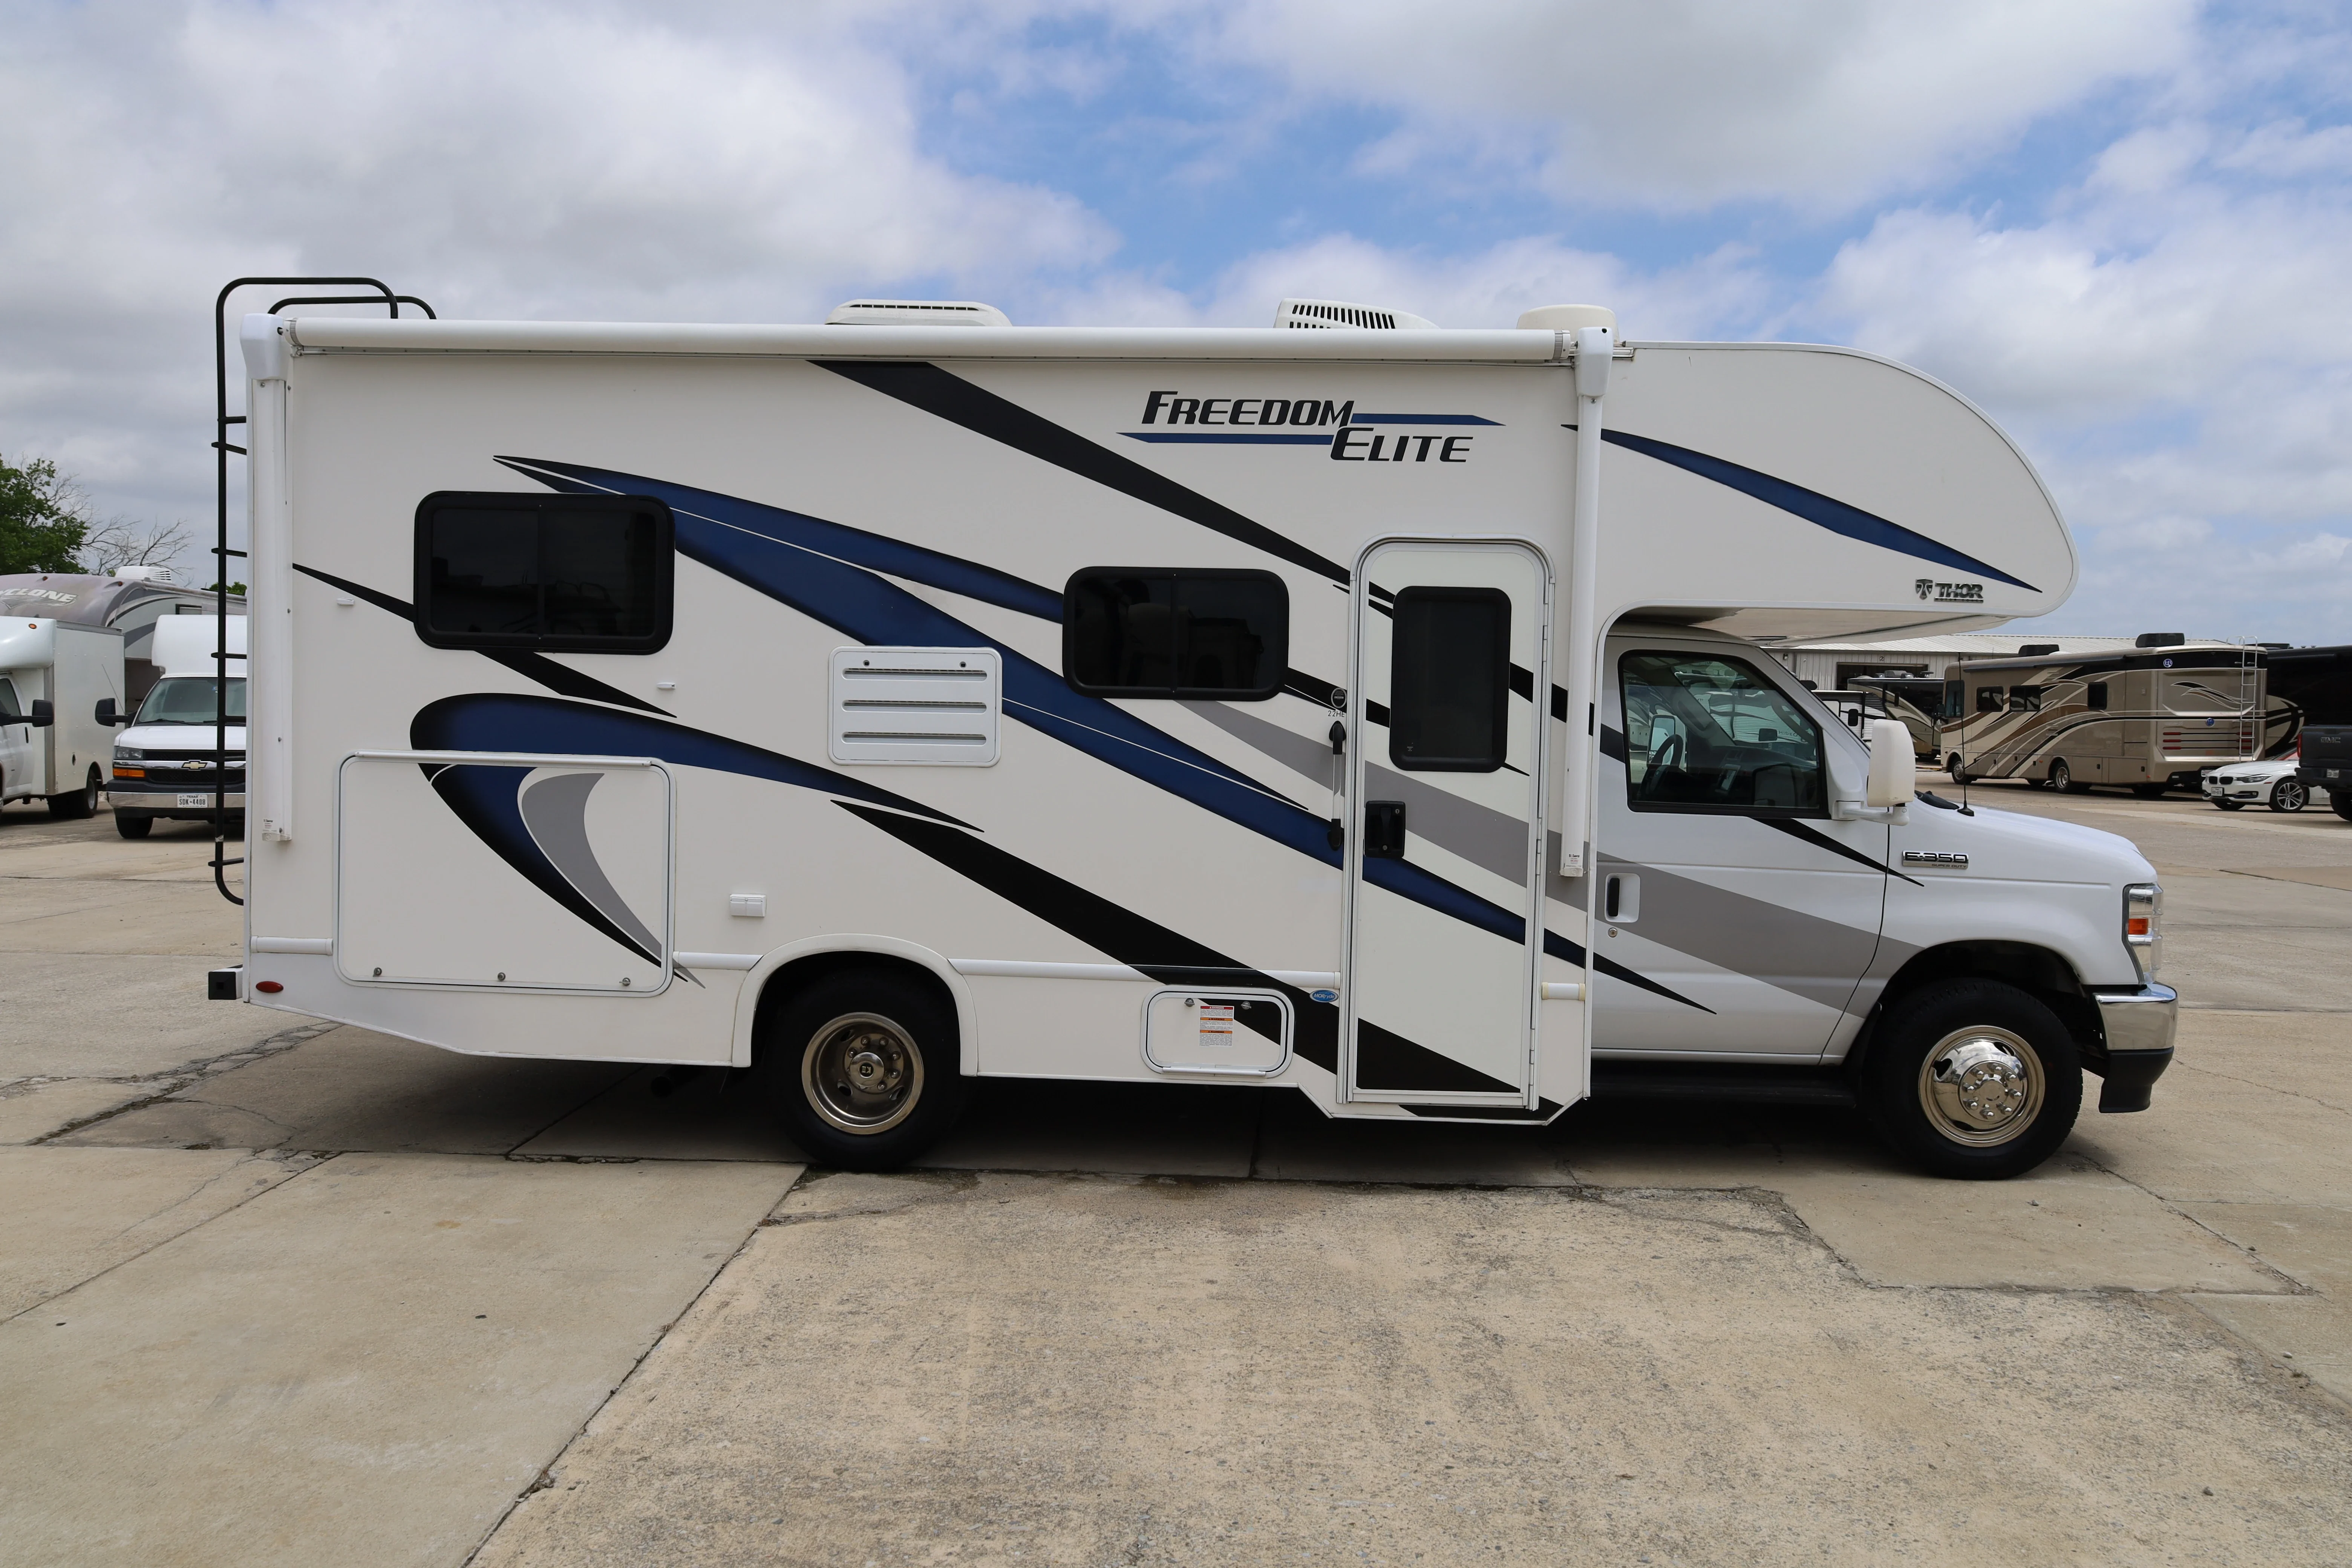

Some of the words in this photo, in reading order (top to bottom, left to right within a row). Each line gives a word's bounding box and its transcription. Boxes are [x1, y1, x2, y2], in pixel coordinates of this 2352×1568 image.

[1141, 390, 1355, 426] FREEDOM
[1330, 427, 1474, 462] ELITE
[0, 588, 78, 603] YCLONE
[1935, 582, 1983, 599] THOR
